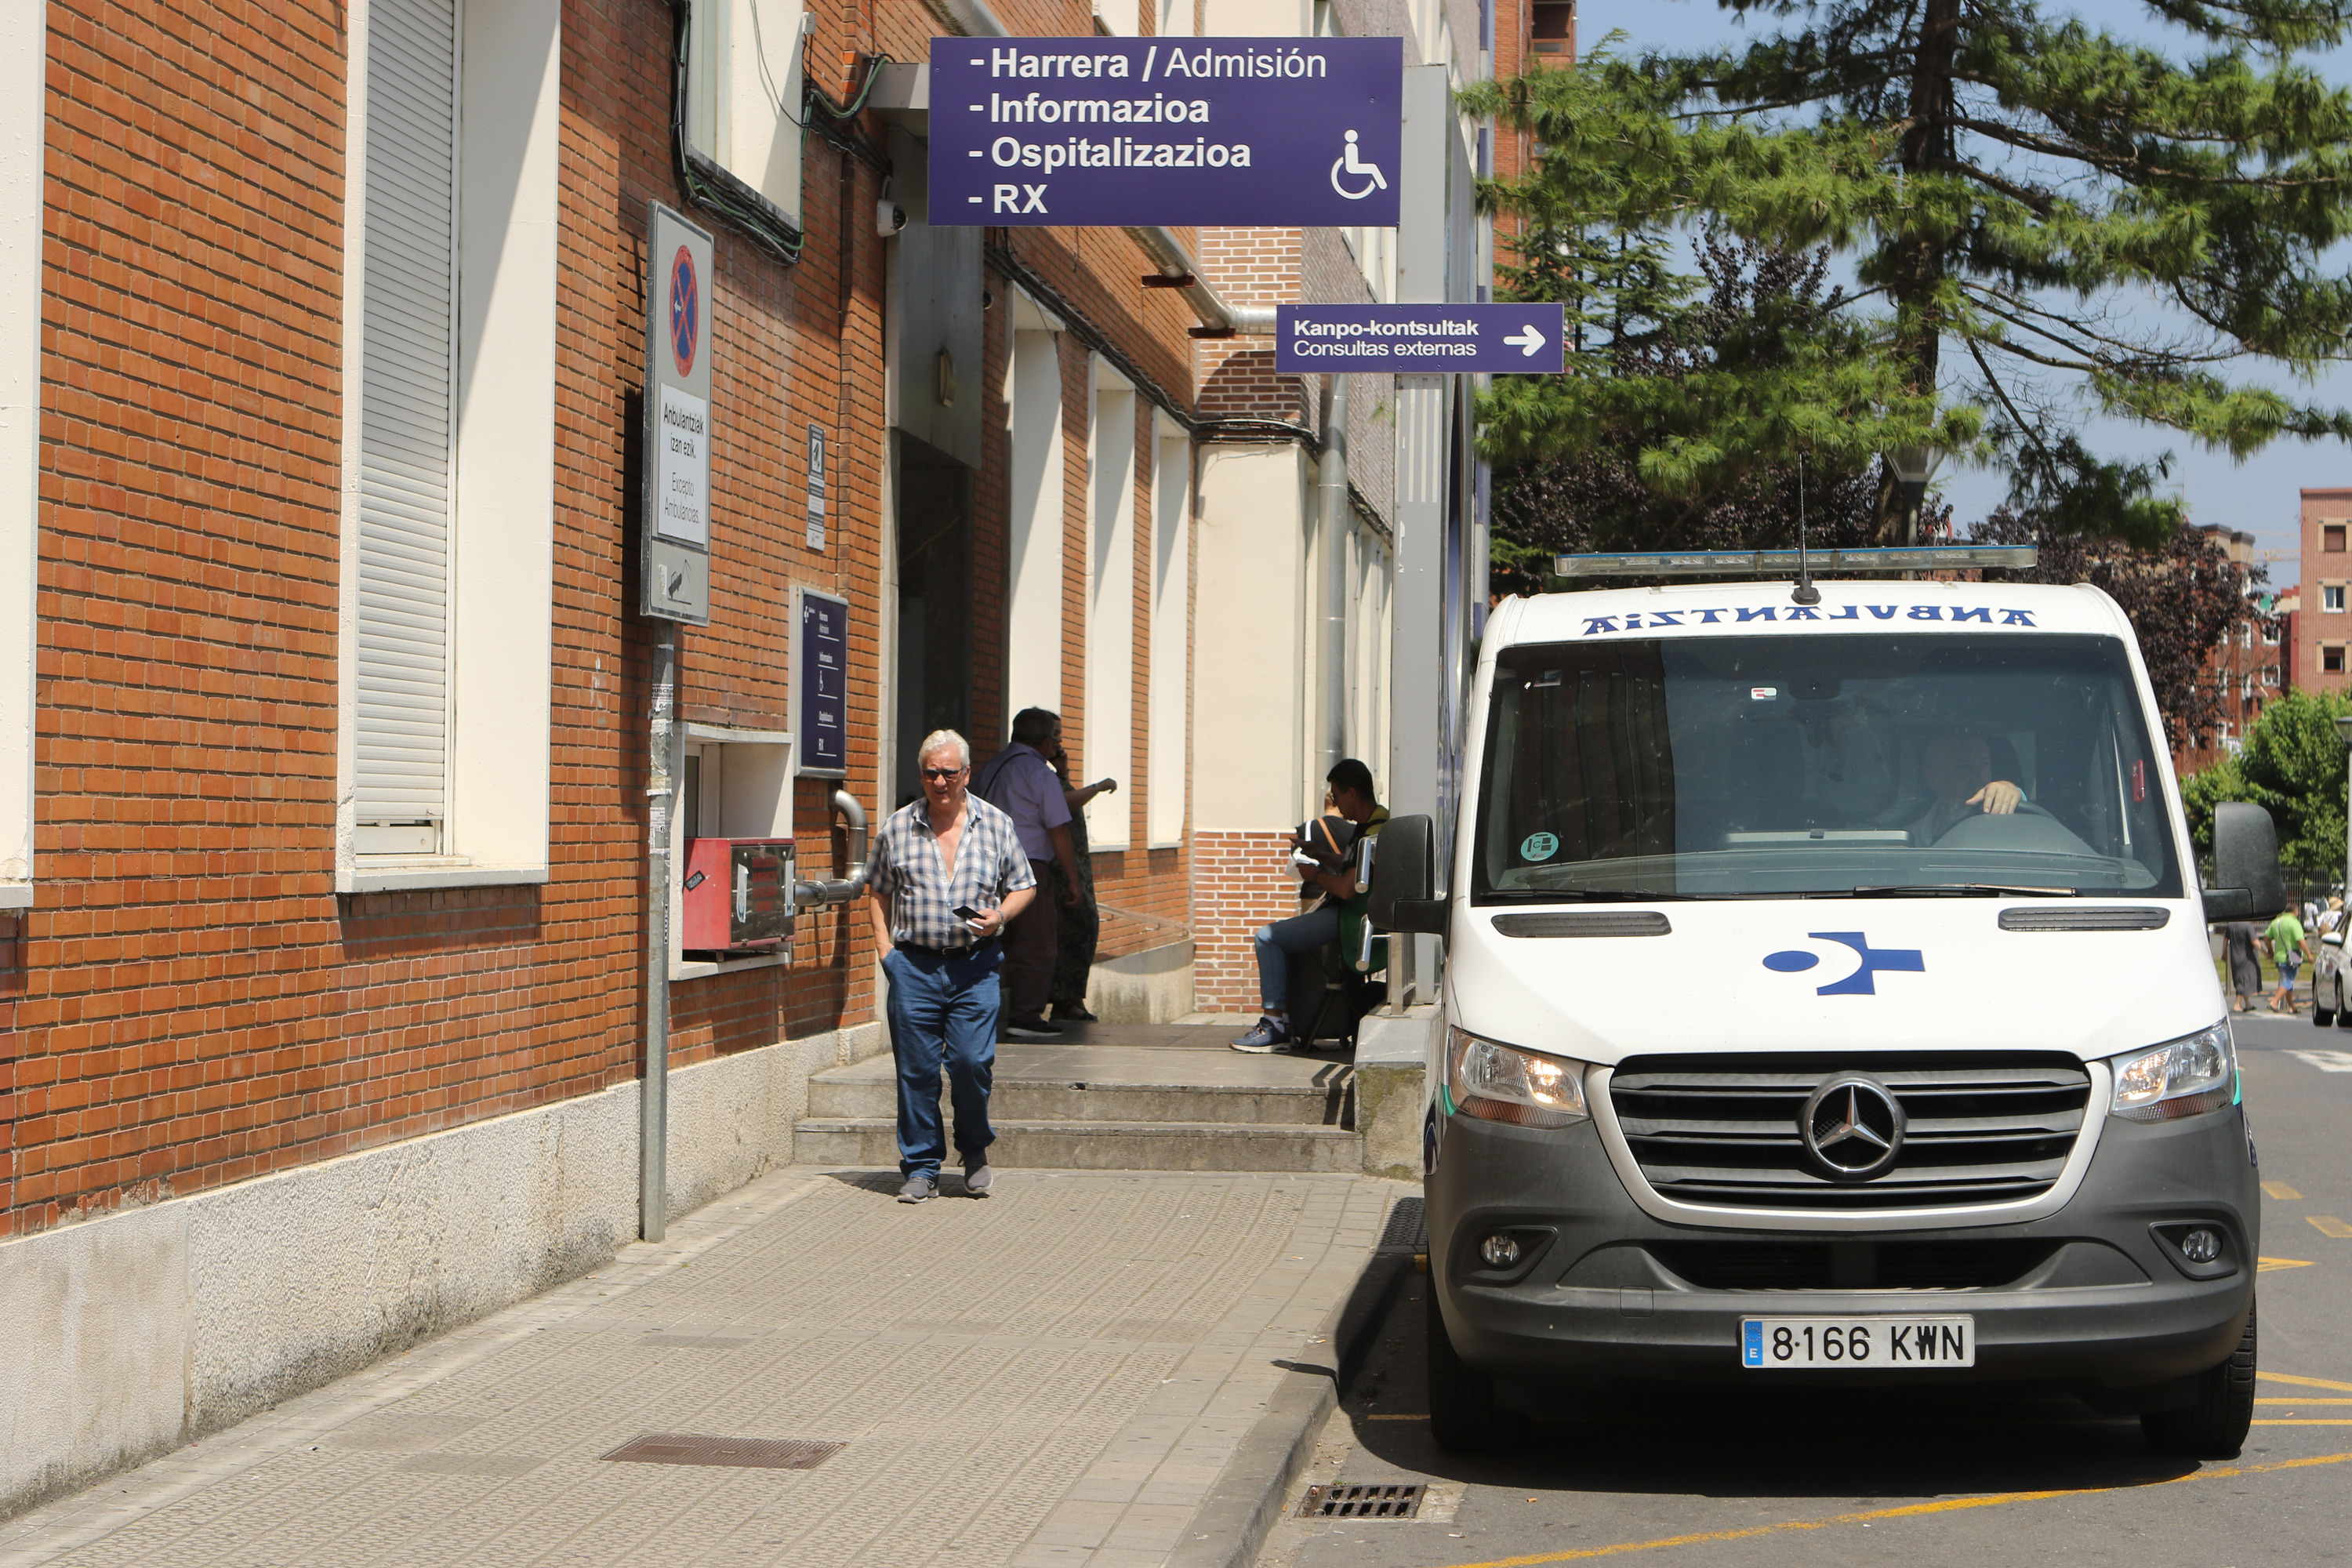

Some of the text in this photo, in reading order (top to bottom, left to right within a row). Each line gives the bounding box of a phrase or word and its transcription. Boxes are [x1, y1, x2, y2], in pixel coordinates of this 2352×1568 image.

[1164, 46, 1327, 78] Admisión
[1294, 319, 1479, 340] Kanpo-kontsultak
[1294, 339, 1477, 357] Consultas externas
[663, 402, 704, 436] Anbulantziak
[670, 432, 682, 454] izan
[672, 472, 695, 499] Excepto
[1749, 1325, 1964, 1361] E 8166 KWN
